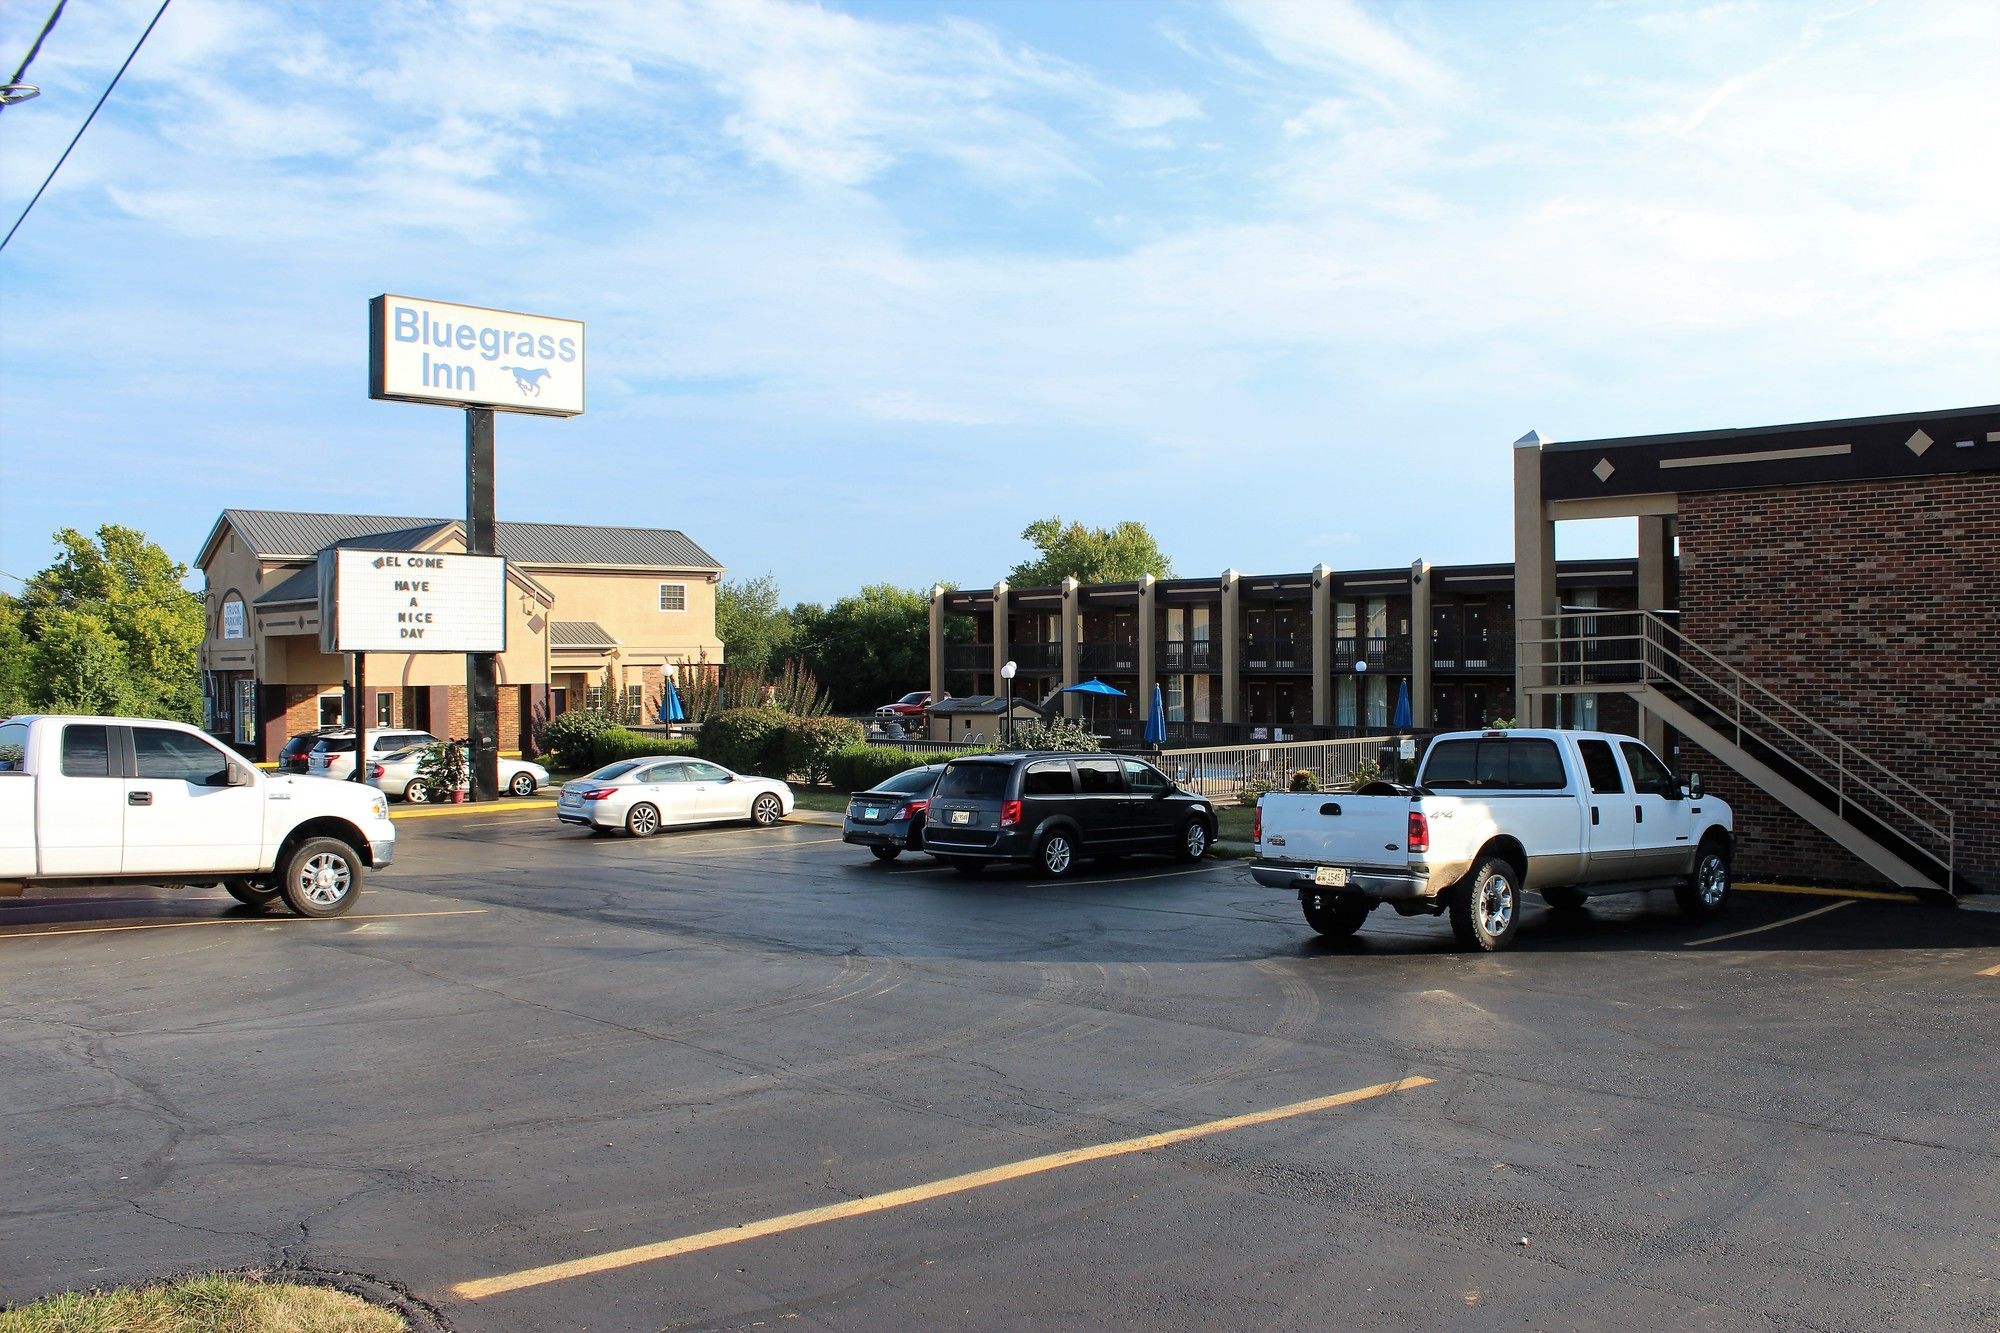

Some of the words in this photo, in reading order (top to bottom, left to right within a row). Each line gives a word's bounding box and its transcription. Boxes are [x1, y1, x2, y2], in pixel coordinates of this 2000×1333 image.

[394, 306, 577, 363] Bluegrass
[422, 352, 476, 392] Inn
[394, 580, 429, 592] HAVE
[409, 597, 418, 607] A
[398, 612, 433, 624] NICE
[400, 628, 425, 639] DAY
